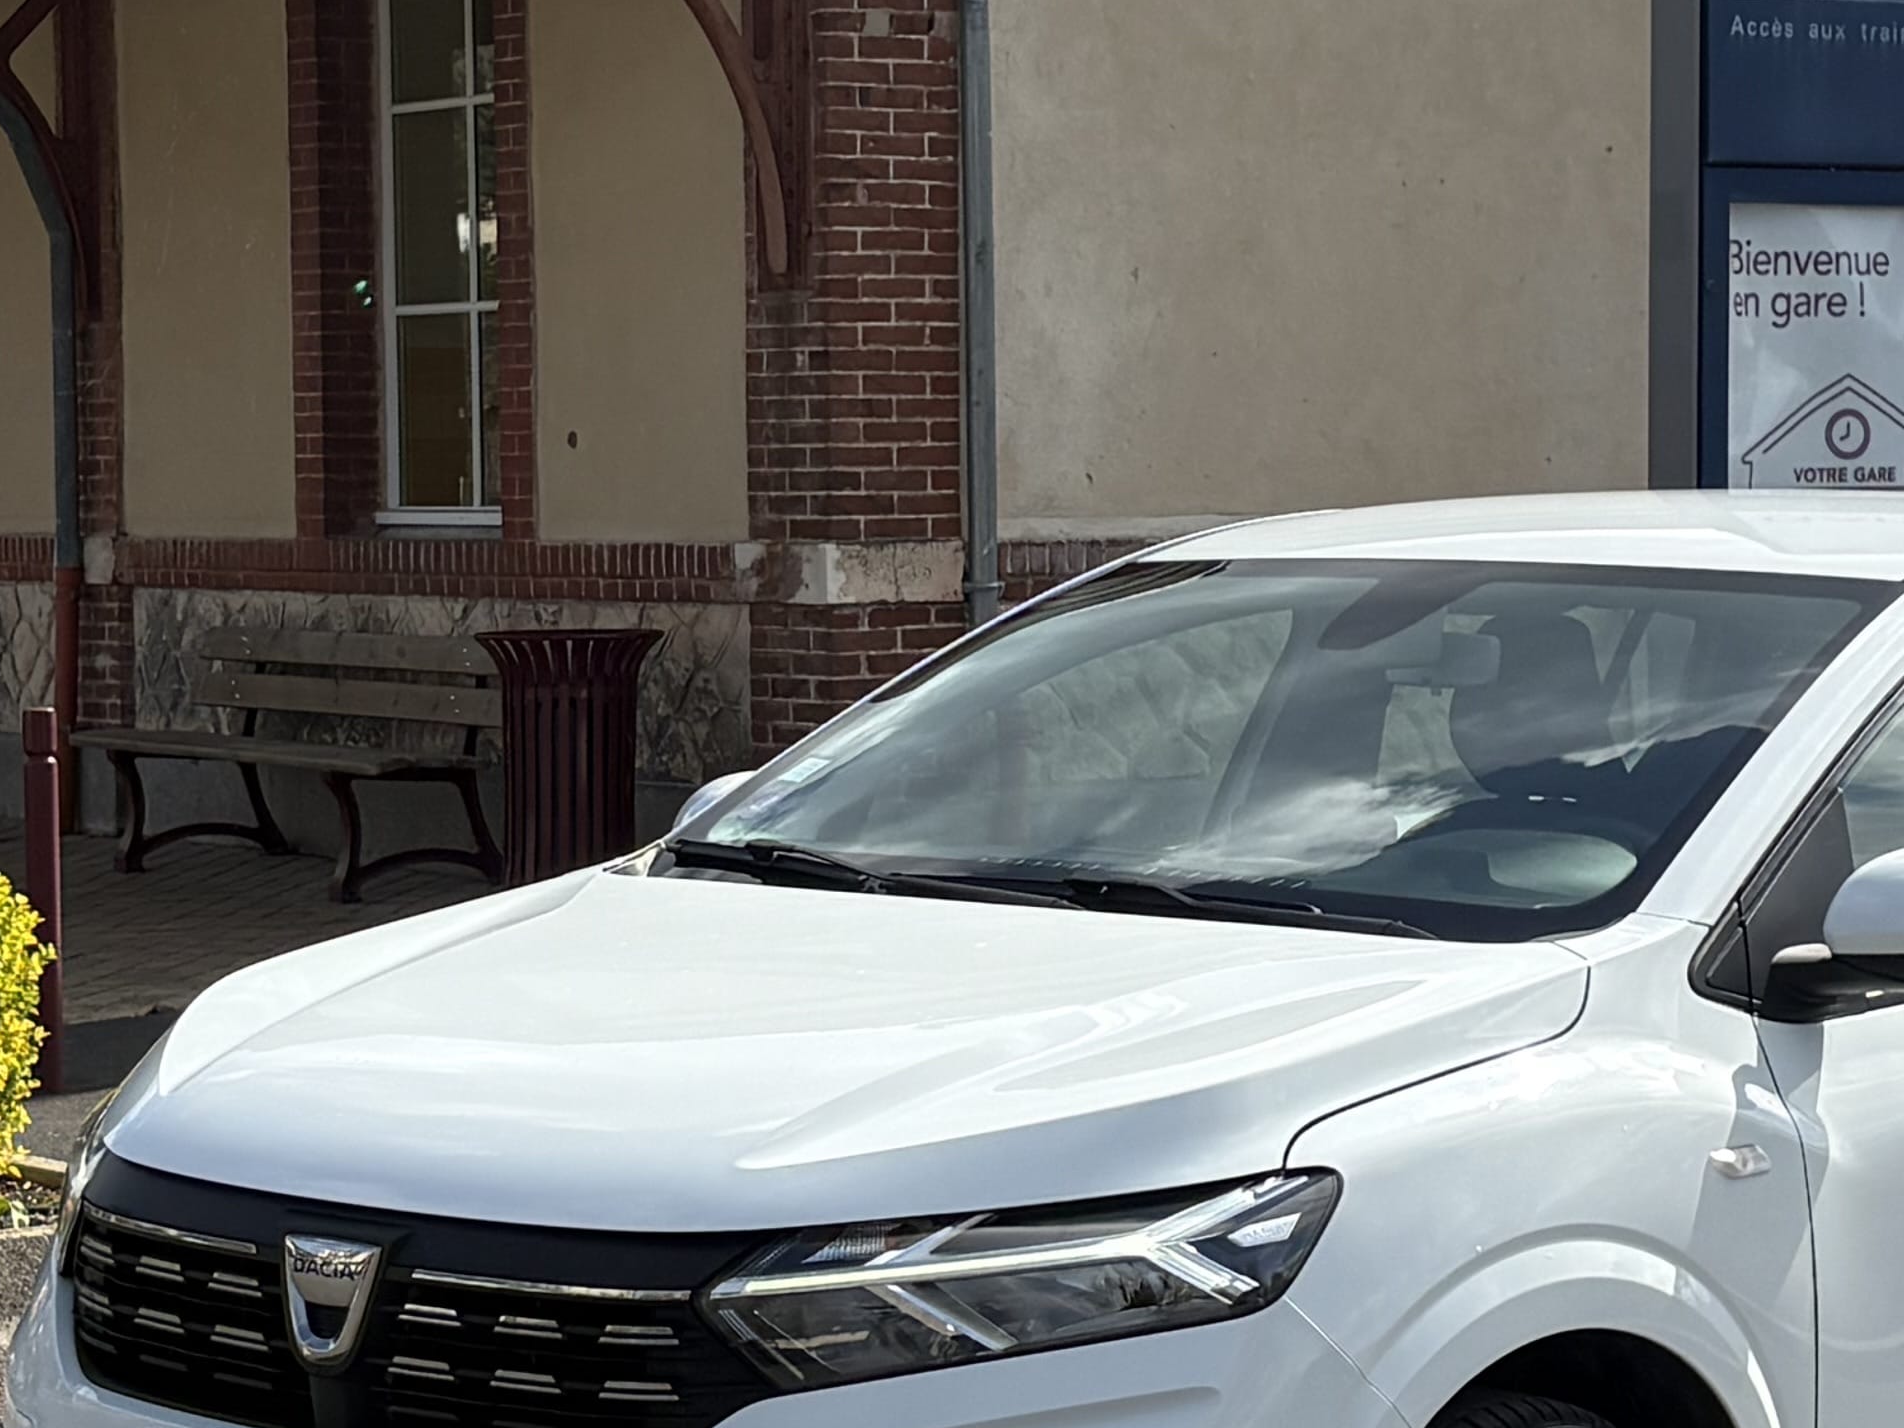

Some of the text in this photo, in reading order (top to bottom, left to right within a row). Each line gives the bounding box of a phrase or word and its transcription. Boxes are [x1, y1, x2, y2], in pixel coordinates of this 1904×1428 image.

[1730, 14, 1794, 38] Accès
[1808, 22, 1846, 41] aux
[1730, 238, 1890, 276] Bienvenue
[1733, 292, 1759, 318] en
[1771, 291, 1848, 329] gare
[1793, 466, 1848, 483] VOTRE
[1853, 466, 1897, 483] GARE
[293, 1256, 355, 1281] DACIA
